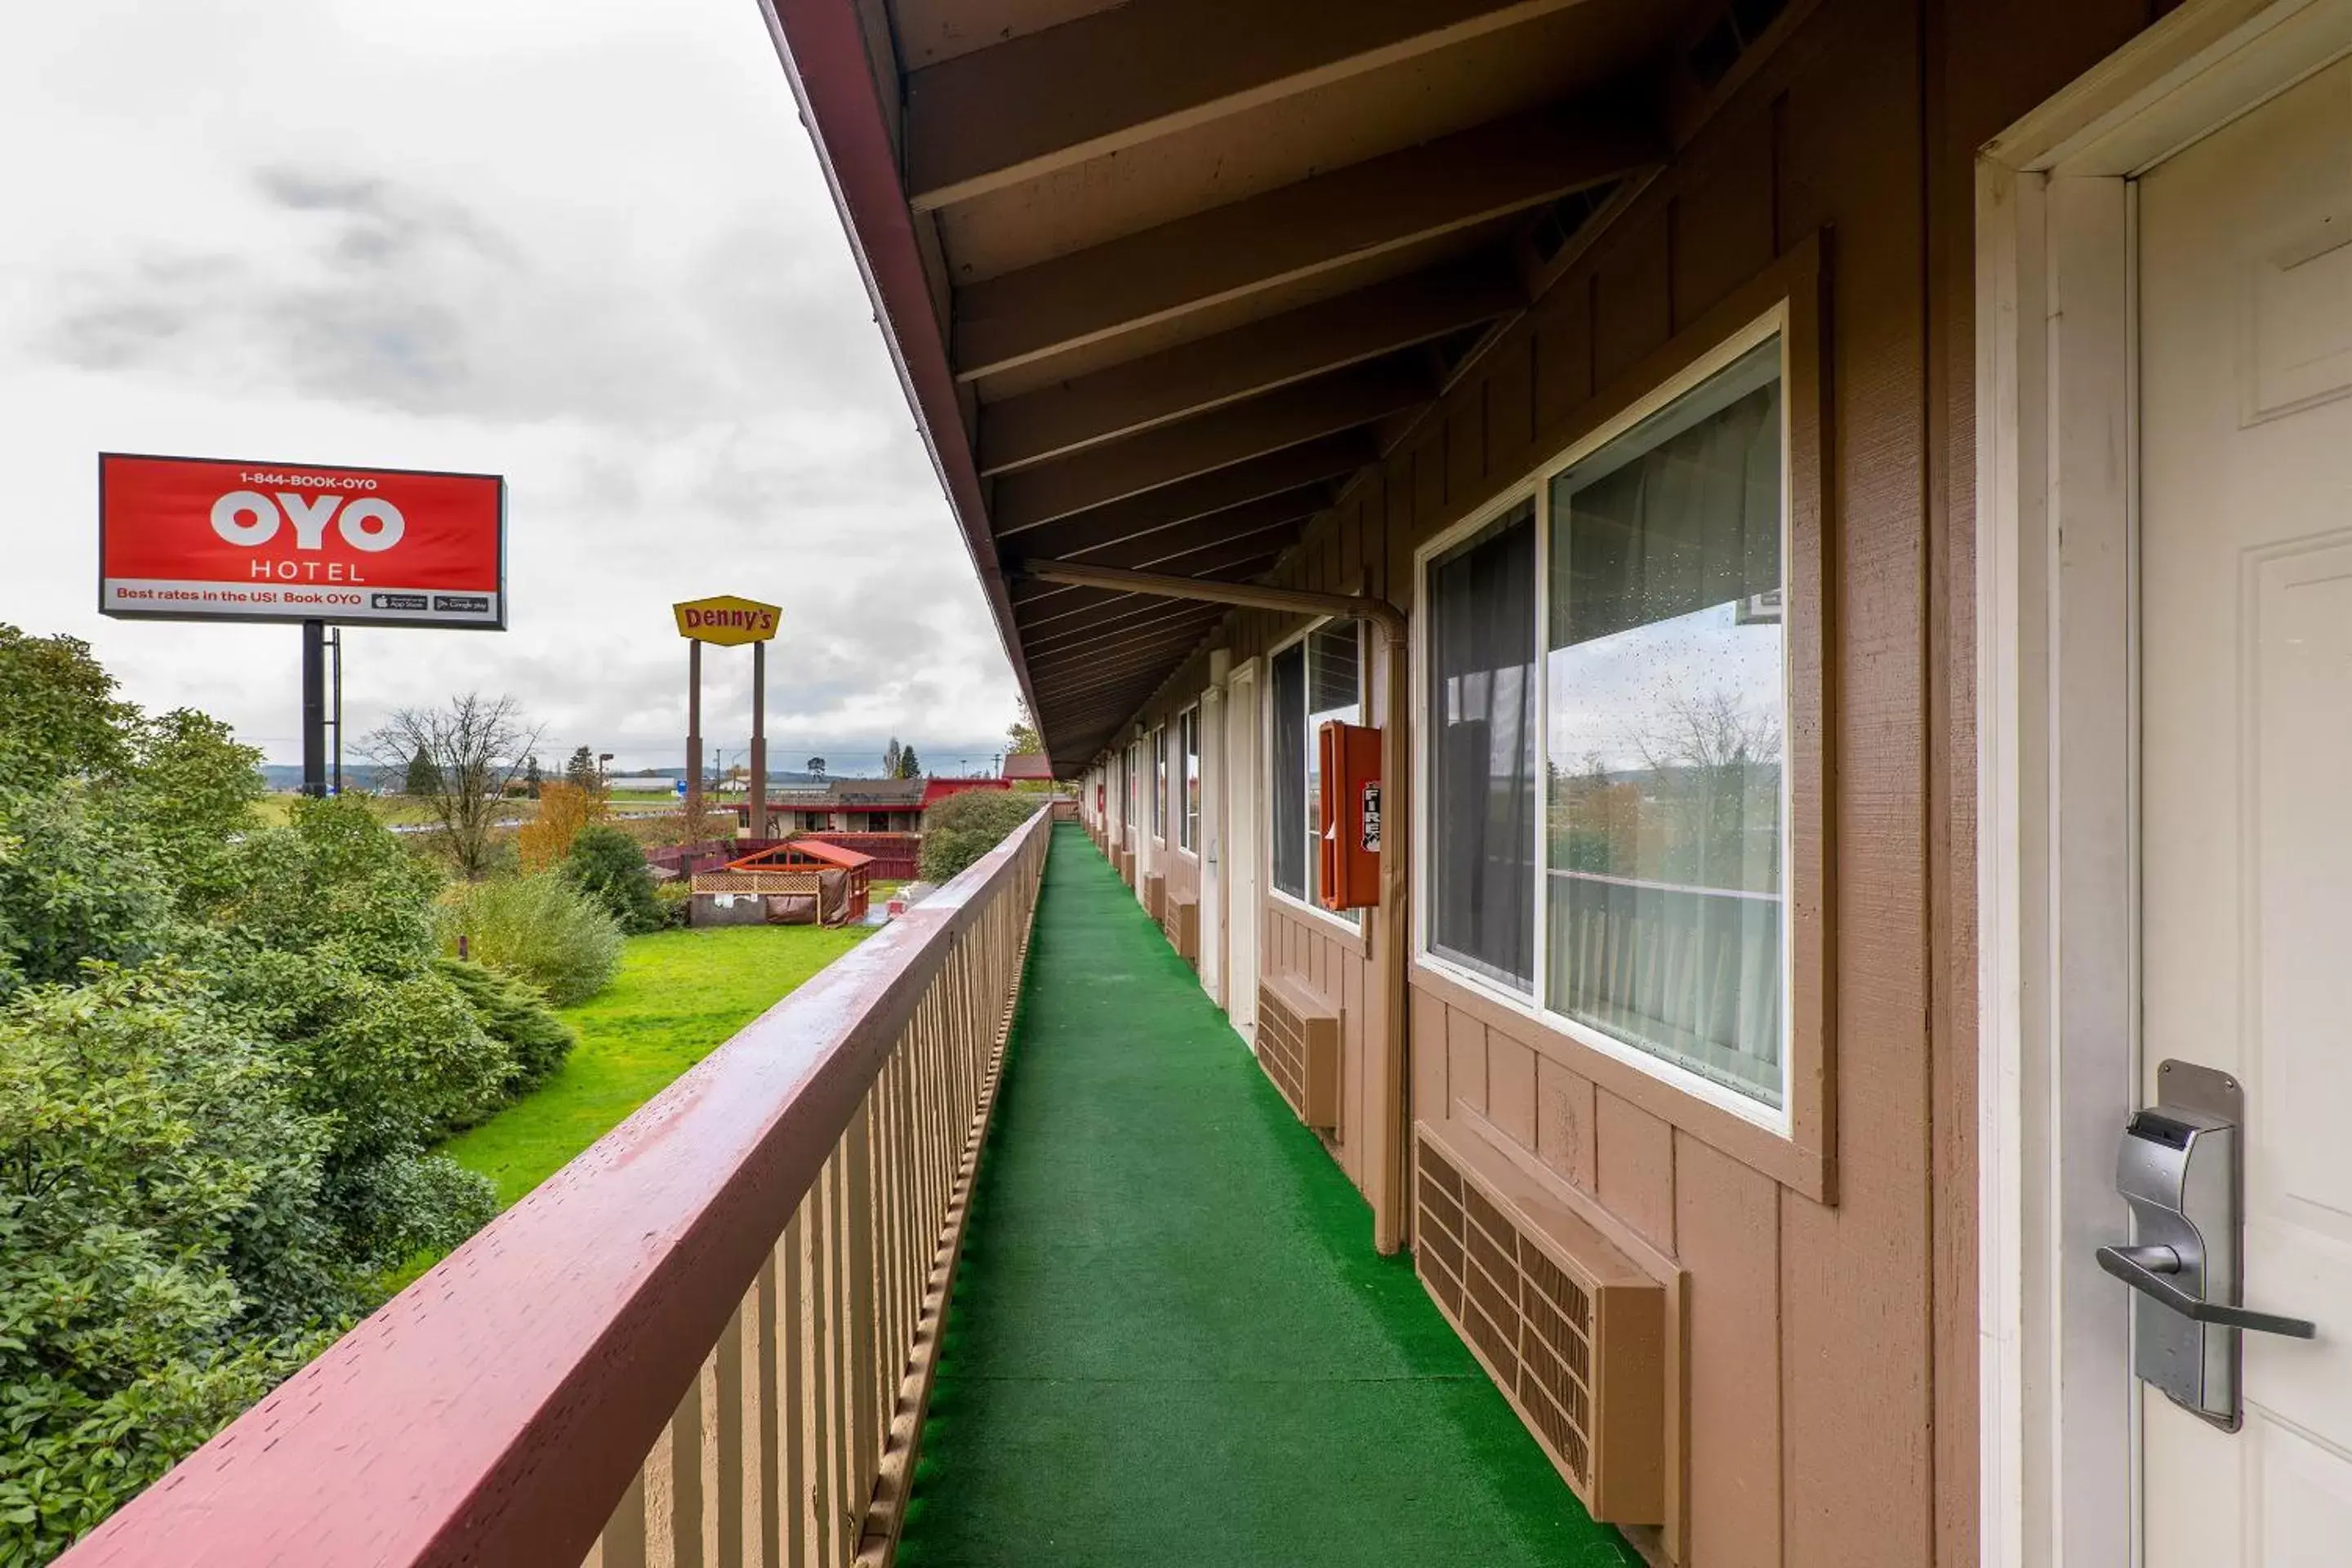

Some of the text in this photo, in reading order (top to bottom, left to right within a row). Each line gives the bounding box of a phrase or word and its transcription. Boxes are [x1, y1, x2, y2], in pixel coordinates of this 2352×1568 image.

[240, 472, 377, 490] 1-844-BOOK-OYO
[210, 490, 405, 552] OYO
[252, 559, 365, 581] HOTEL
[117, 587, 362, 604] Best rates in the US! Book OYO
[684, 608, 773, 631] Denny's
[1365, 790, 1380, 834] FIRE
